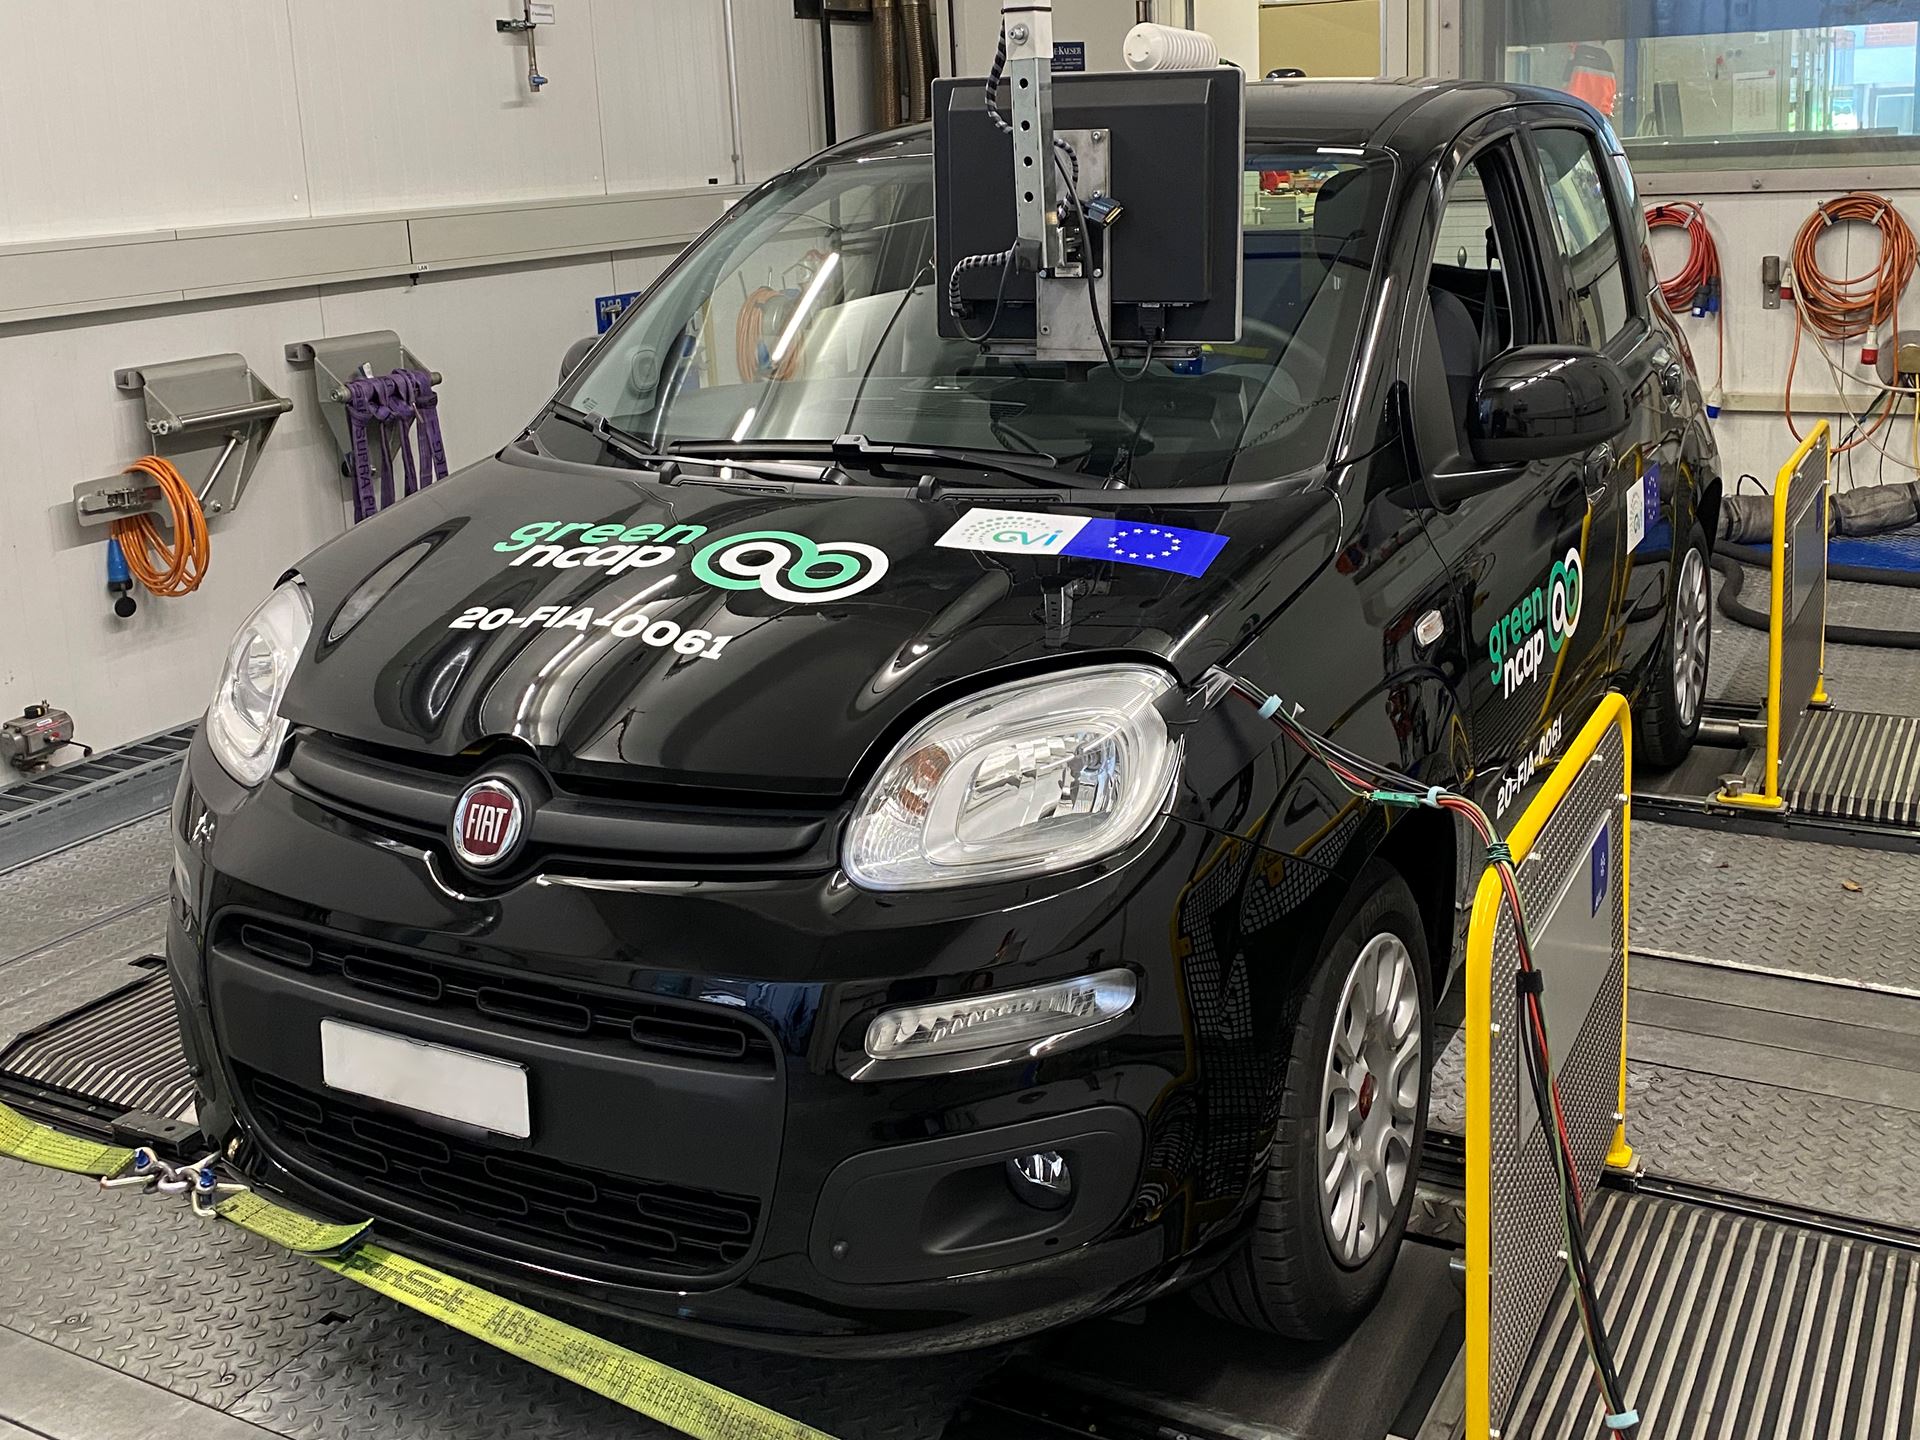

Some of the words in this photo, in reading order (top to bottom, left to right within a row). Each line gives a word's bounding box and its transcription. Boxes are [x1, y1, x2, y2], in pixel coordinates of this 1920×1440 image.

[355, 427, 371, 489] SUPRA
[493, 520, 708, 552] green
[508, 541, 676, 575] ncap
[448, 606, 734, 660] 20-FIA-0061
[1489, 586, 1543, 685] green
[1504, 628, 1545, 700] ncap
[1496, 713, 1563, 820] 20-FIA-0061
[465, 803, 508, 844] FIAT
